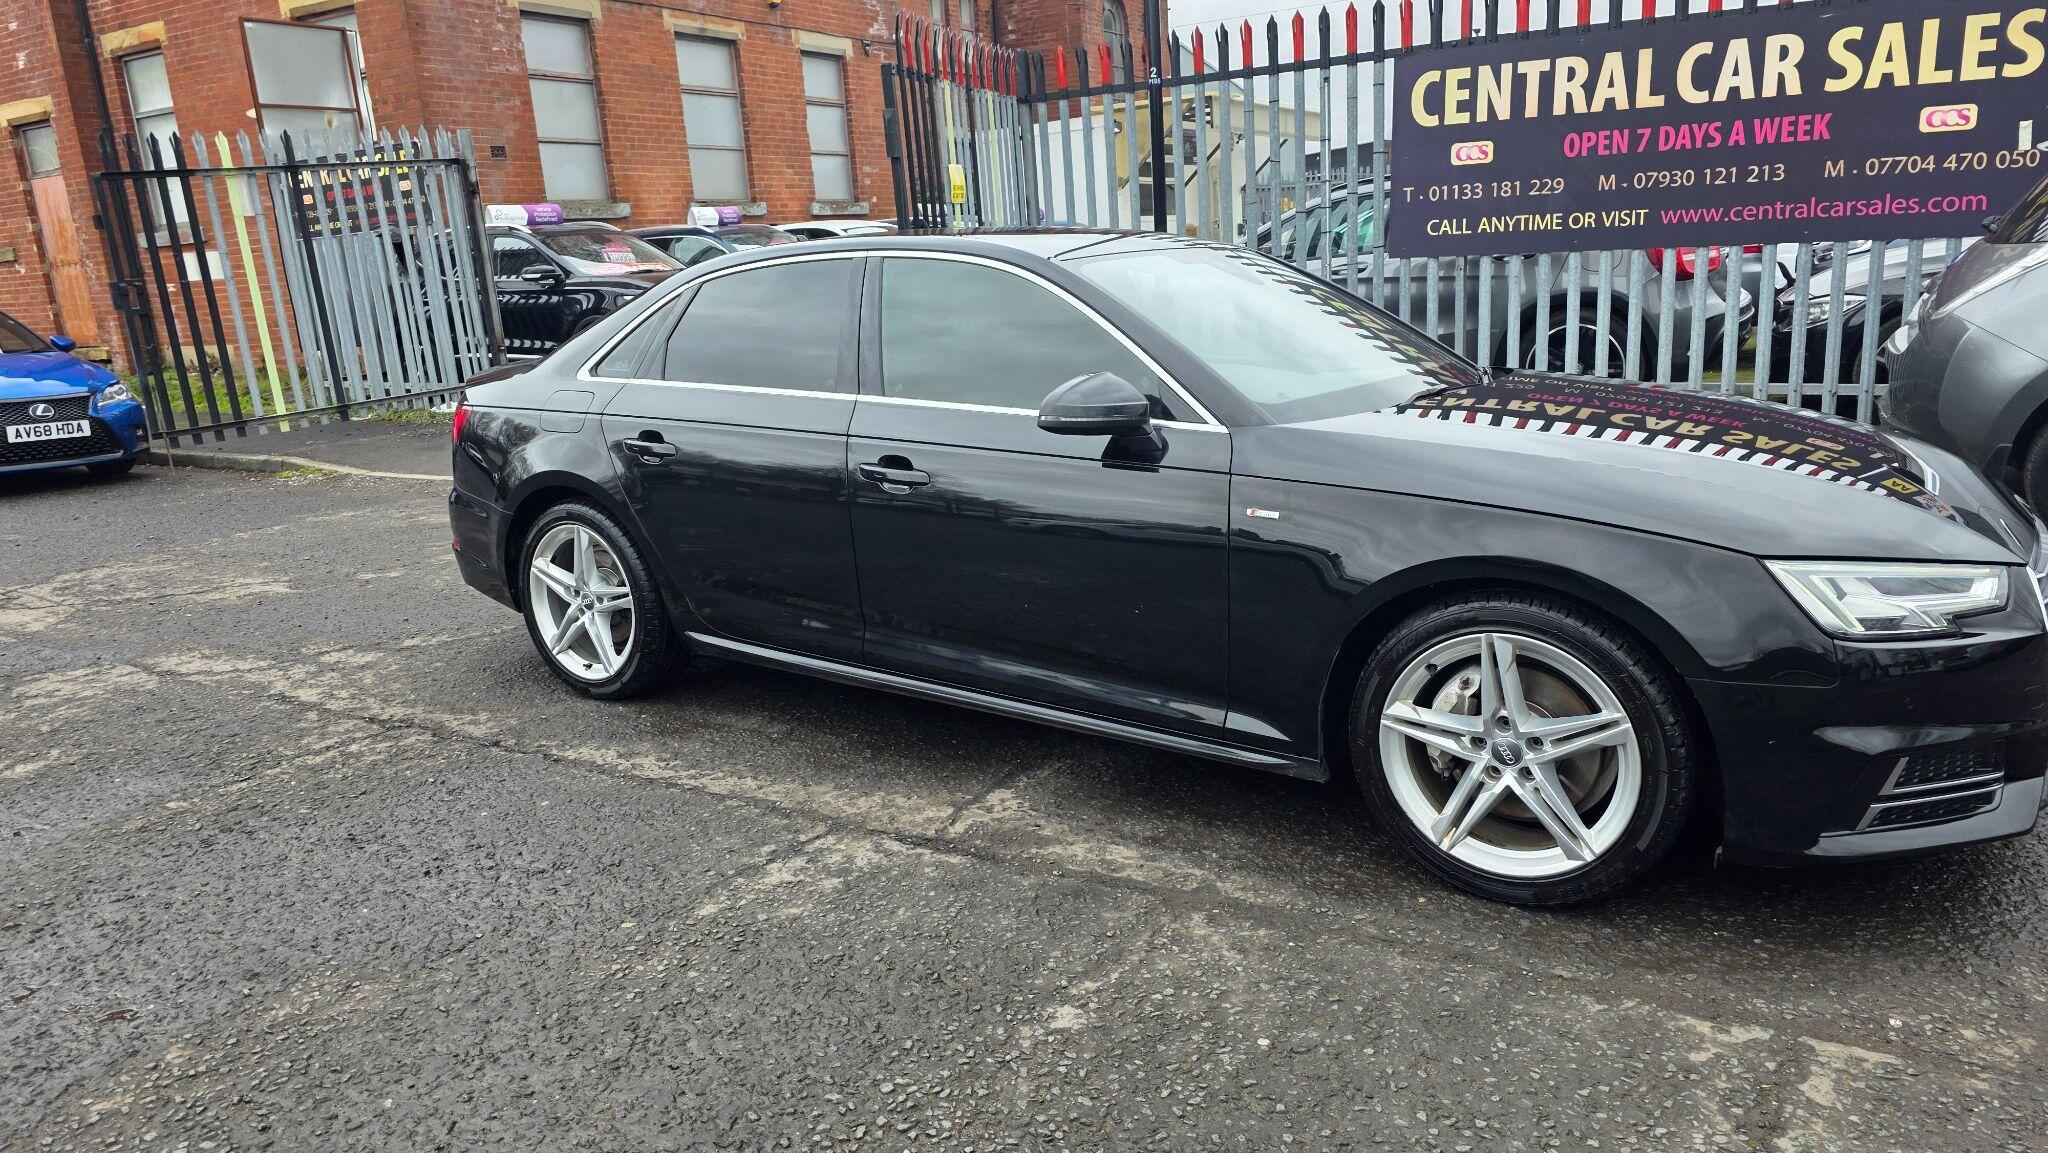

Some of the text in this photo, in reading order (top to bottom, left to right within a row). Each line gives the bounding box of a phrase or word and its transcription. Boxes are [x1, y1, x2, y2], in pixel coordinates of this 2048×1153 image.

[1150, 66, 1157, 77] 2
[1410, 8, 2047, 128] CENTRAL CAR SALES
[1563, 112, 1833, 158] OPEN 7 DAYS A WEEK
[1865, 152, 1936, 176] 07704
[1942, 150, 1988, 172] 470
[1995, 148, 2041, 169] 050
[1428, 182, 1484, 202] 01133
[1490, 180, 1521, 198] 181
[1527, 177, 1565, 196] 229
[1633, 169, 1695, 189] 07930
[1703, 166, 1737, 185] 121
[1746, 163, 1785, 183] 213
[1426, 193, 1988, 236] CALL ANYTIME OR VISIT www.centralcarsales.com
[14, 421, 84, 440] AV68 HDA
